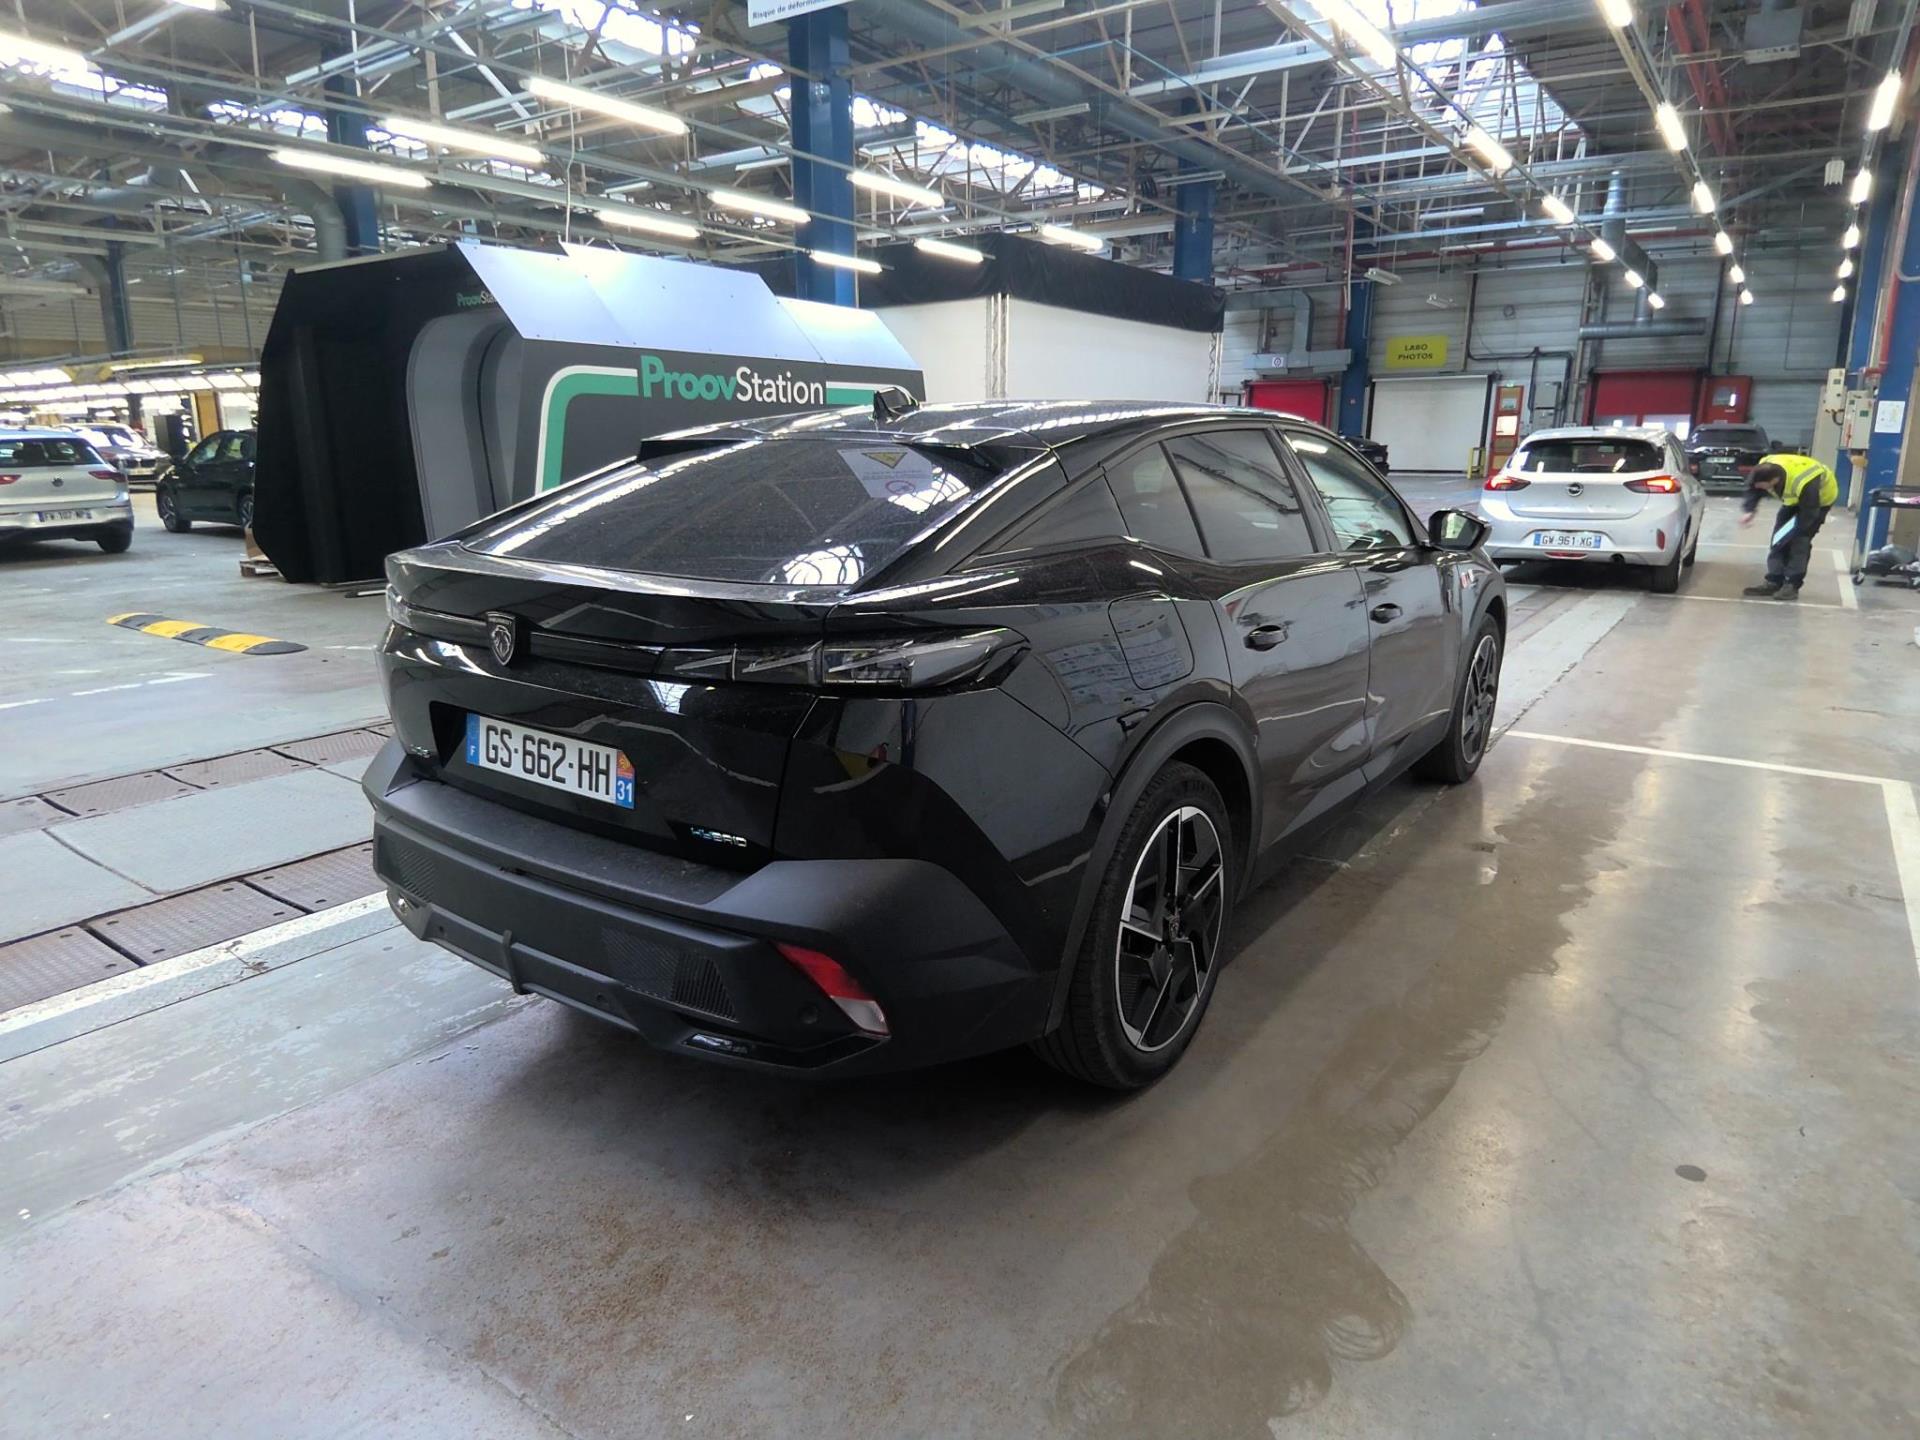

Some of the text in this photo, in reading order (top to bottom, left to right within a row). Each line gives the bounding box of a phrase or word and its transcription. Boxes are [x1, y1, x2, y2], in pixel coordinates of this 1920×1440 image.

[752, 9, 776, 19] Risque
[777, 5, 786, 13] de
[1404, 343, 1428, 352] LABO
[1398, 352, 1433, 360] PHOTOS
[640, 355, 824, 405] ProovStation
[470, 745, 475, 756] F
[616, 780, 633, 803] 31
